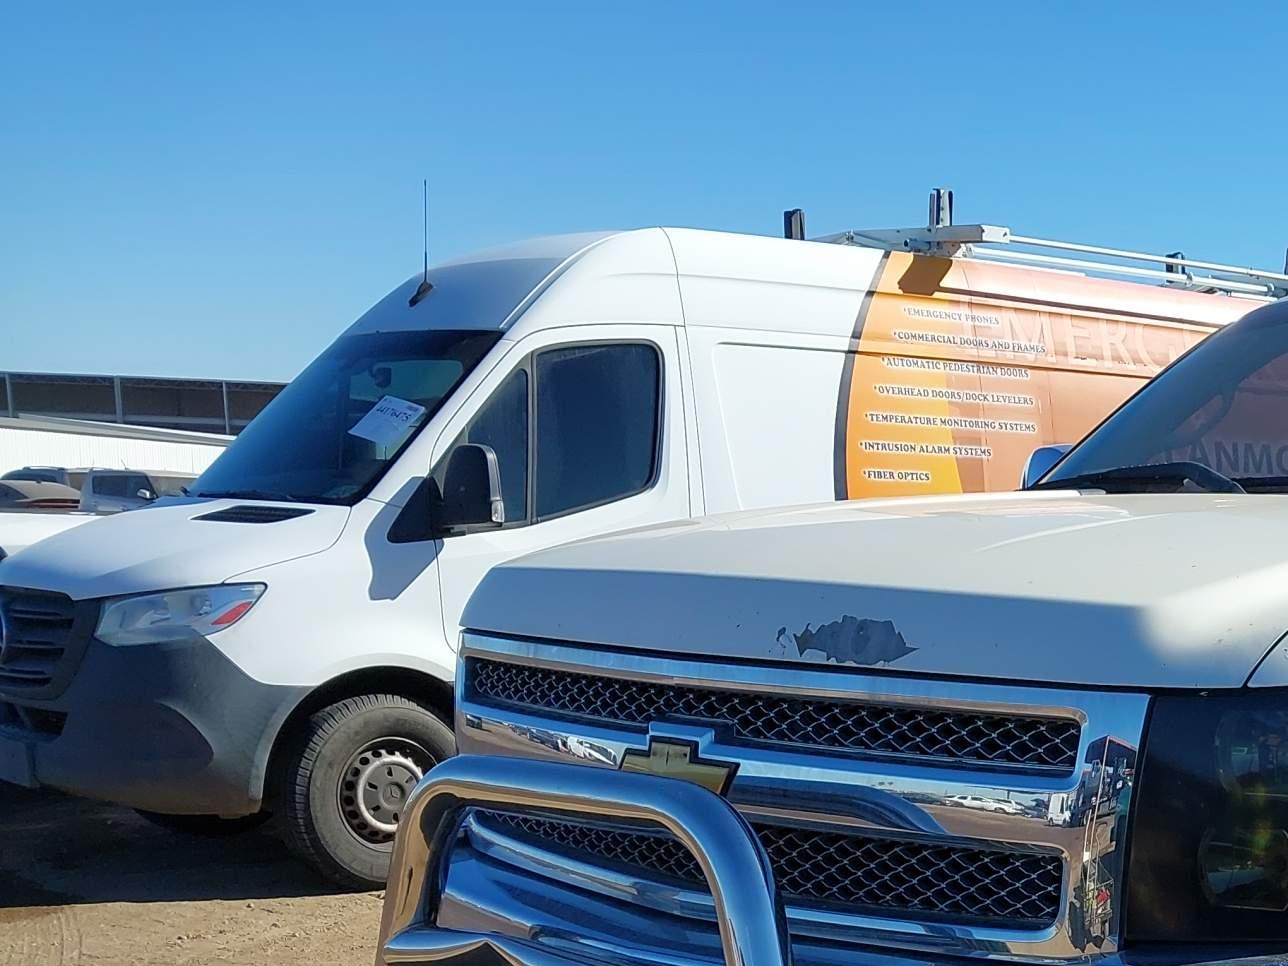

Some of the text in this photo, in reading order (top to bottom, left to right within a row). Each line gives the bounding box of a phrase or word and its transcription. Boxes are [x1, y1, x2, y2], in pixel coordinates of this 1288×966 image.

[908, 307, 1000, 325] EMERGENCY PHONES
[897, 331, 1046, 353] COMMERCIAL DOORS AND FRAMES
[886, 357, 1029, 378] AUTOMATIC PEDESTRIAN DOORS
[878, 385, 1034, 405] OVERHEAD DOORS/DOCK LEVELERS
[869, 413, 1036, 432] TEMPERATURE MONITORING SYSTEMS
[864, 441, 992, 457] INTRUSION ALARM SYSTEMS
[867, 470, 930, 481] FIBER OPTICS
